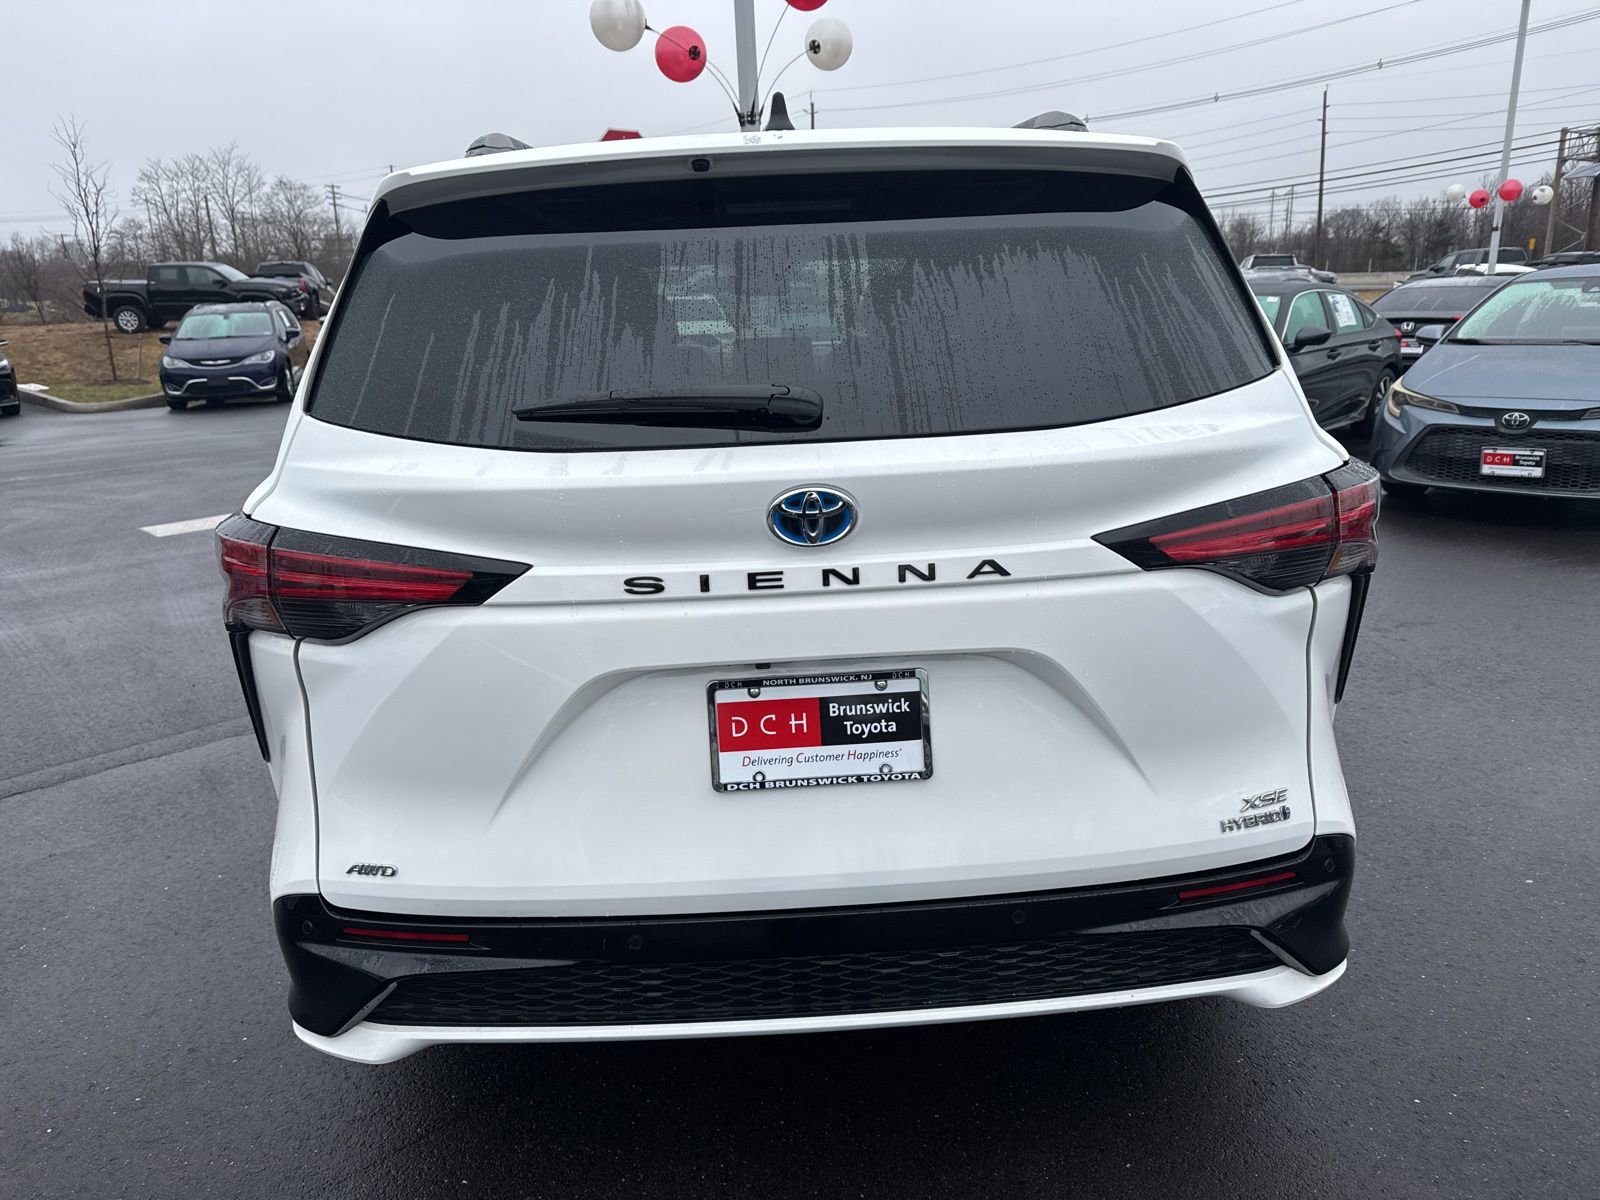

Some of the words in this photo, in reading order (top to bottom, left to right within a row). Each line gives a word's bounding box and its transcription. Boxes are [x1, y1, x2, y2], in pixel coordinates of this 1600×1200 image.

[623, 559, 1012, 595] SIENNA
[762, 678, 796, 686] NORTH
[829, 698, 911, 717] Brunswick
[844, 719, 897, 738] Toyota
[742, 756, 794, 767] Delivering
[796, 752, 845, 763] Customer
[726, 782, 760, 791] DCH
[764, 775, 858, 788] BRUNSWICK
[861, 772, 921, 783] TOYOTA
[1240, 787, 1288, 812] XSE
[1219, 808, 1282, 833] HYBRID
[346, 863, 398, 877] AWD
